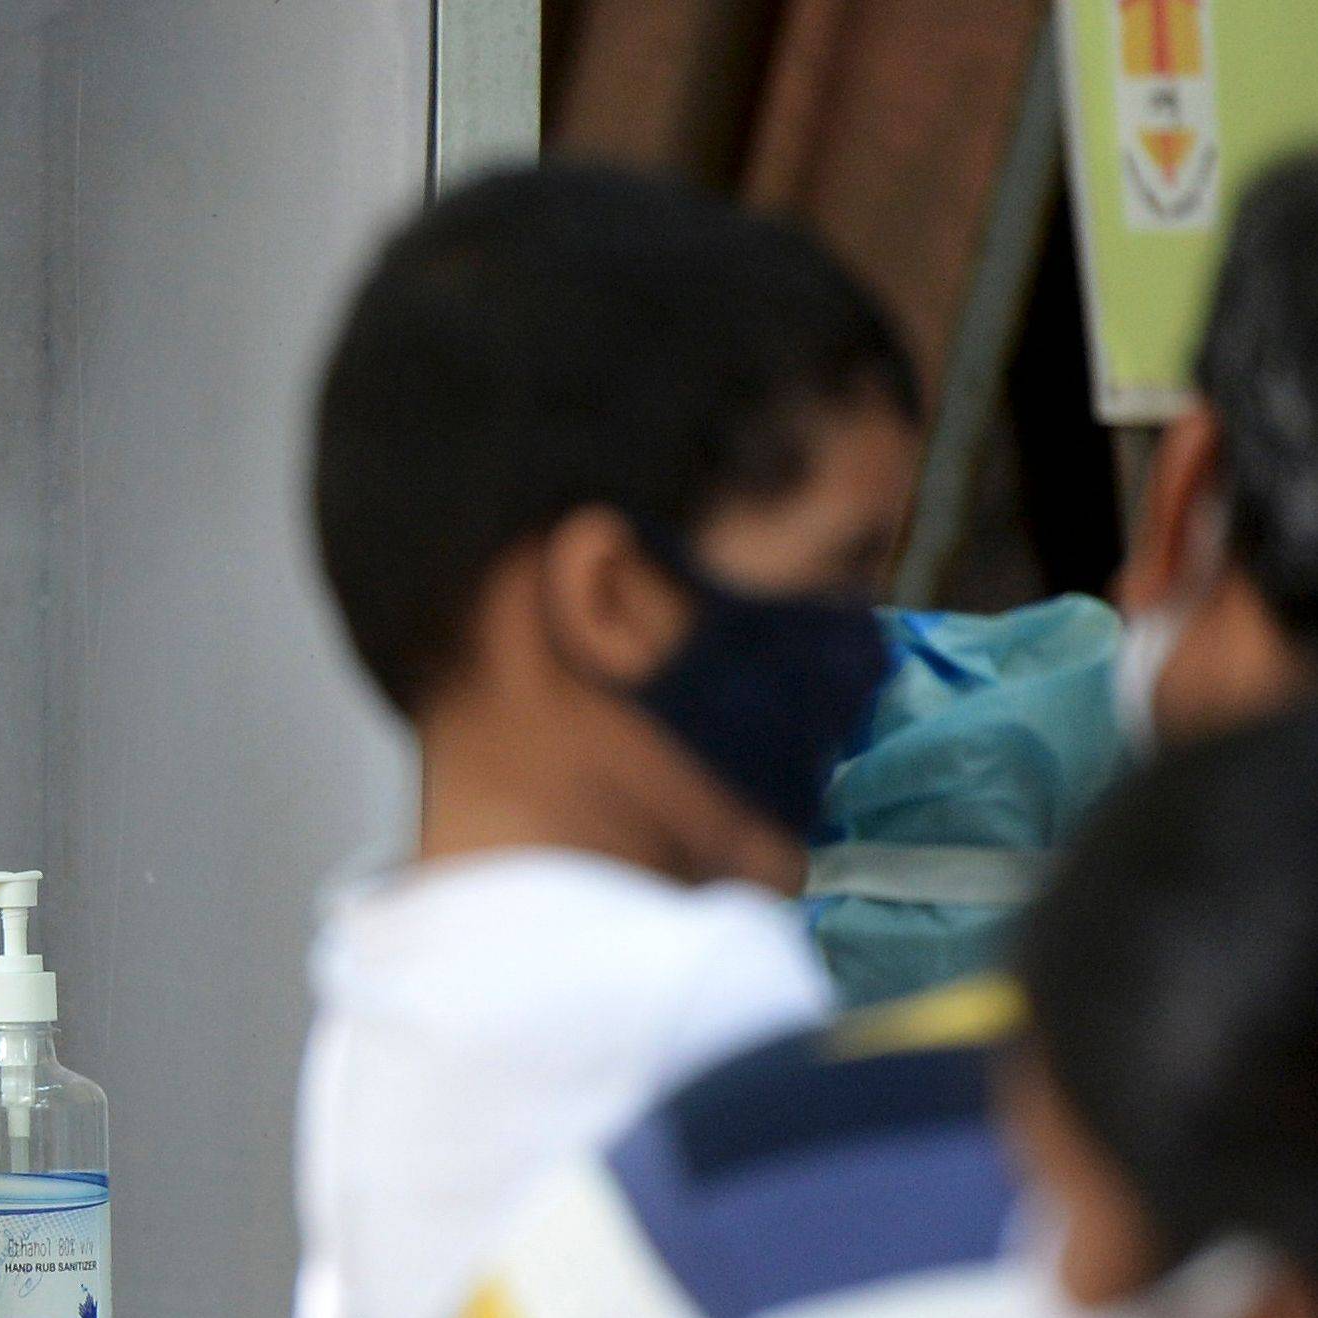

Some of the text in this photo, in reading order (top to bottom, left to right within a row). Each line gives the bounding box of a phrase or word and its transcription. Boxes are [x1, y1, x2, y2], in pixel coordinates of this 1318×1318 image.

[5, 1260, 97, 1273] HAND RUB SANITIZER
